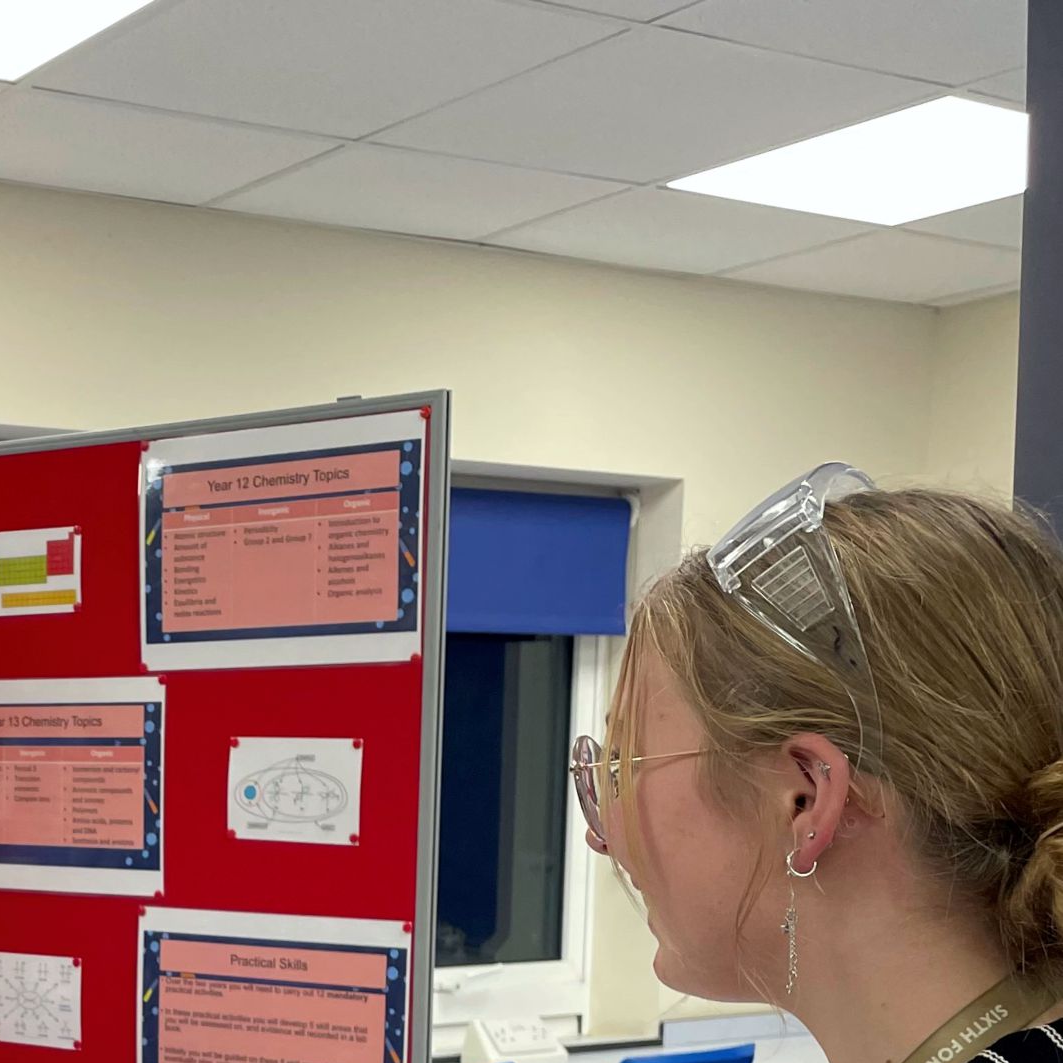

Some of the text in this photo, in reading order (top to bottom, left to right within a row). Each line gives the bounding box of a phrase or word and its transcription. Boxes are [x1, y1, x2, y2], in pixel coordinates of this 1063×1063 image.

[208, 469, 350, 492] Year 12 Chemistry Topics
[9, 716, 20, 727] 13
[22, 716, 68, 730] Chemistry
[72, 716, 102, 728] Topics
[230, 954, 308, 971] Practical Skills
[327, 991, 368, 1003] mandatory
[958, 1004, 1009, 1044] SIXTH
